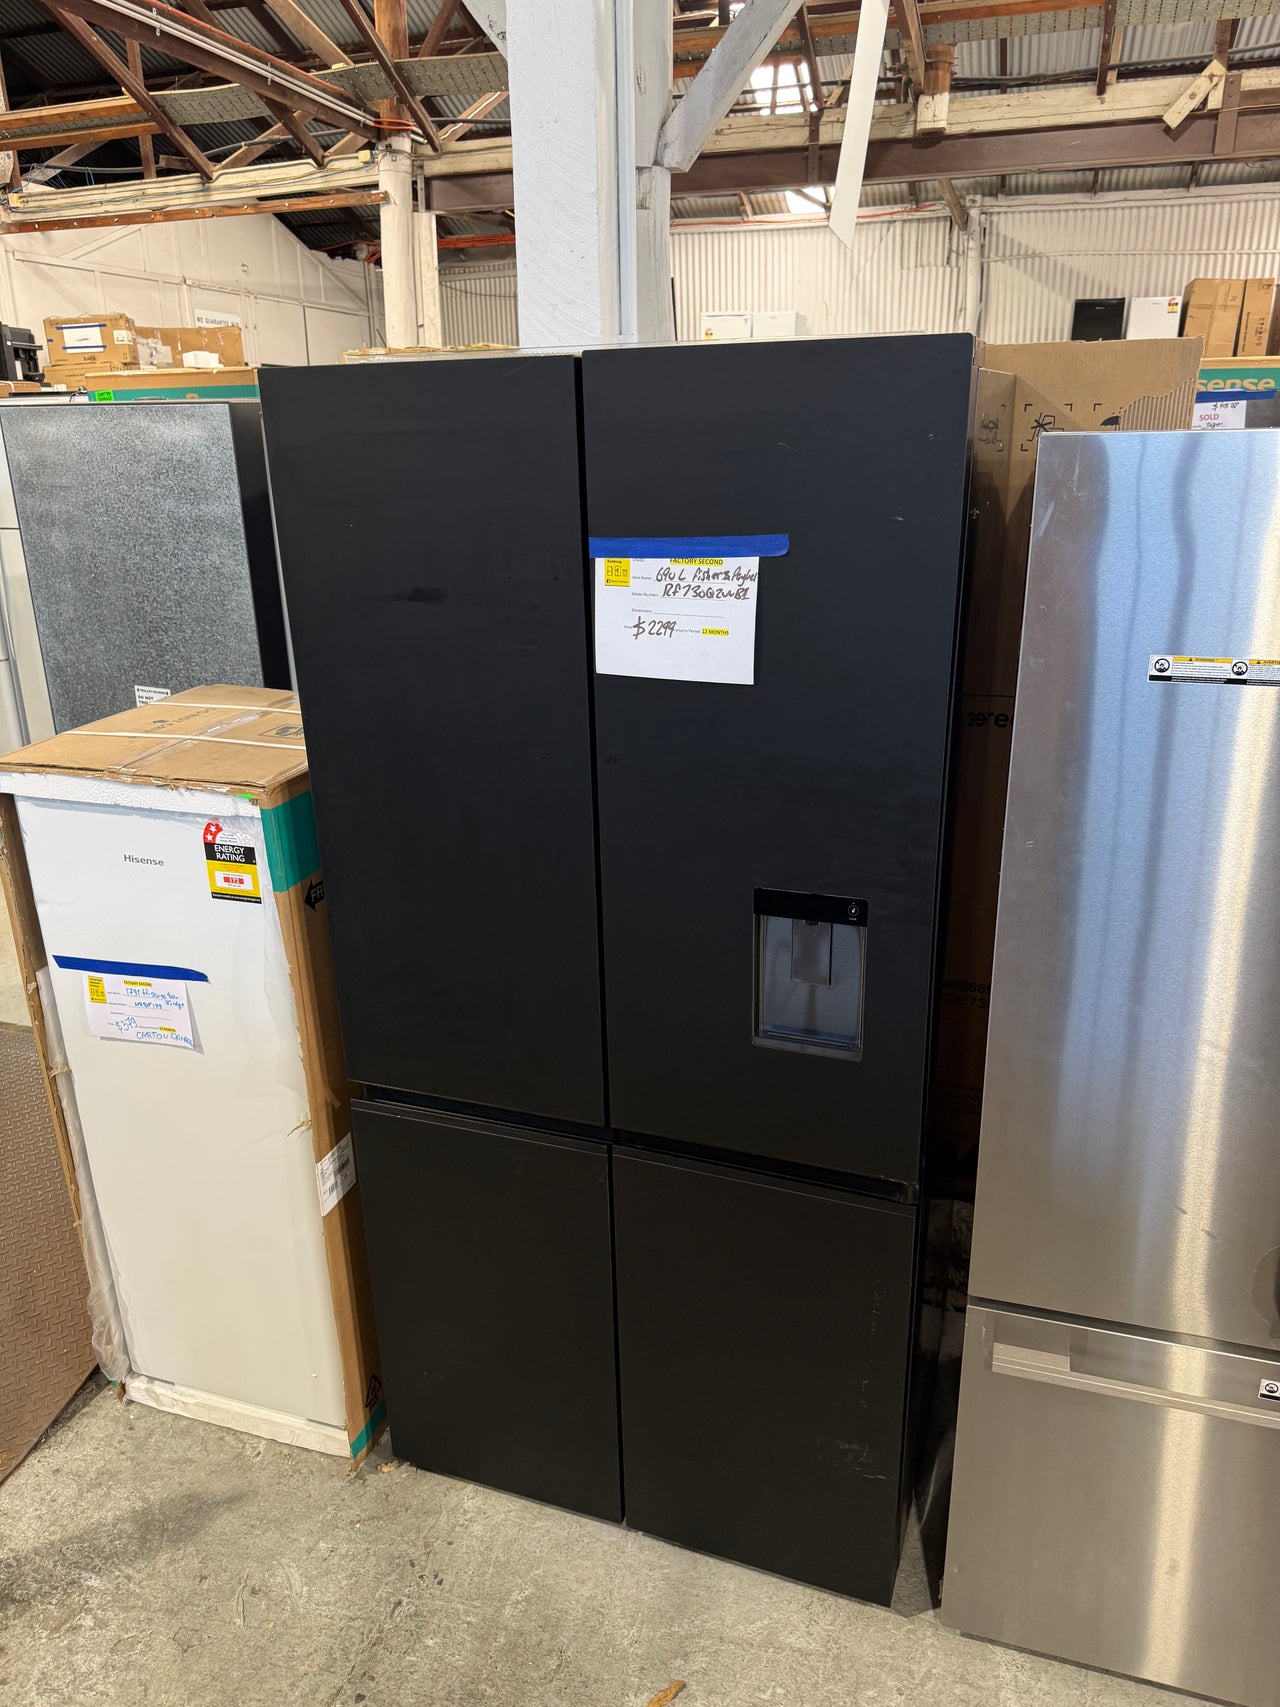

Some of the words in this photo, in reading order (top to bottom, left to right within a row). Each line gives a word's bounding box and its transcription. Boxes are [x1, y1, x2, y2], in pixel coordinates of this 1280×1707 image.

[214, 845, 244, 854] ENERGY
[124, 854, 165, 866] Hisense
[216, 853, 245, 862] RATING
[311, 885, 324, 902] FR
[115, 1016, 138, 1033] $379
